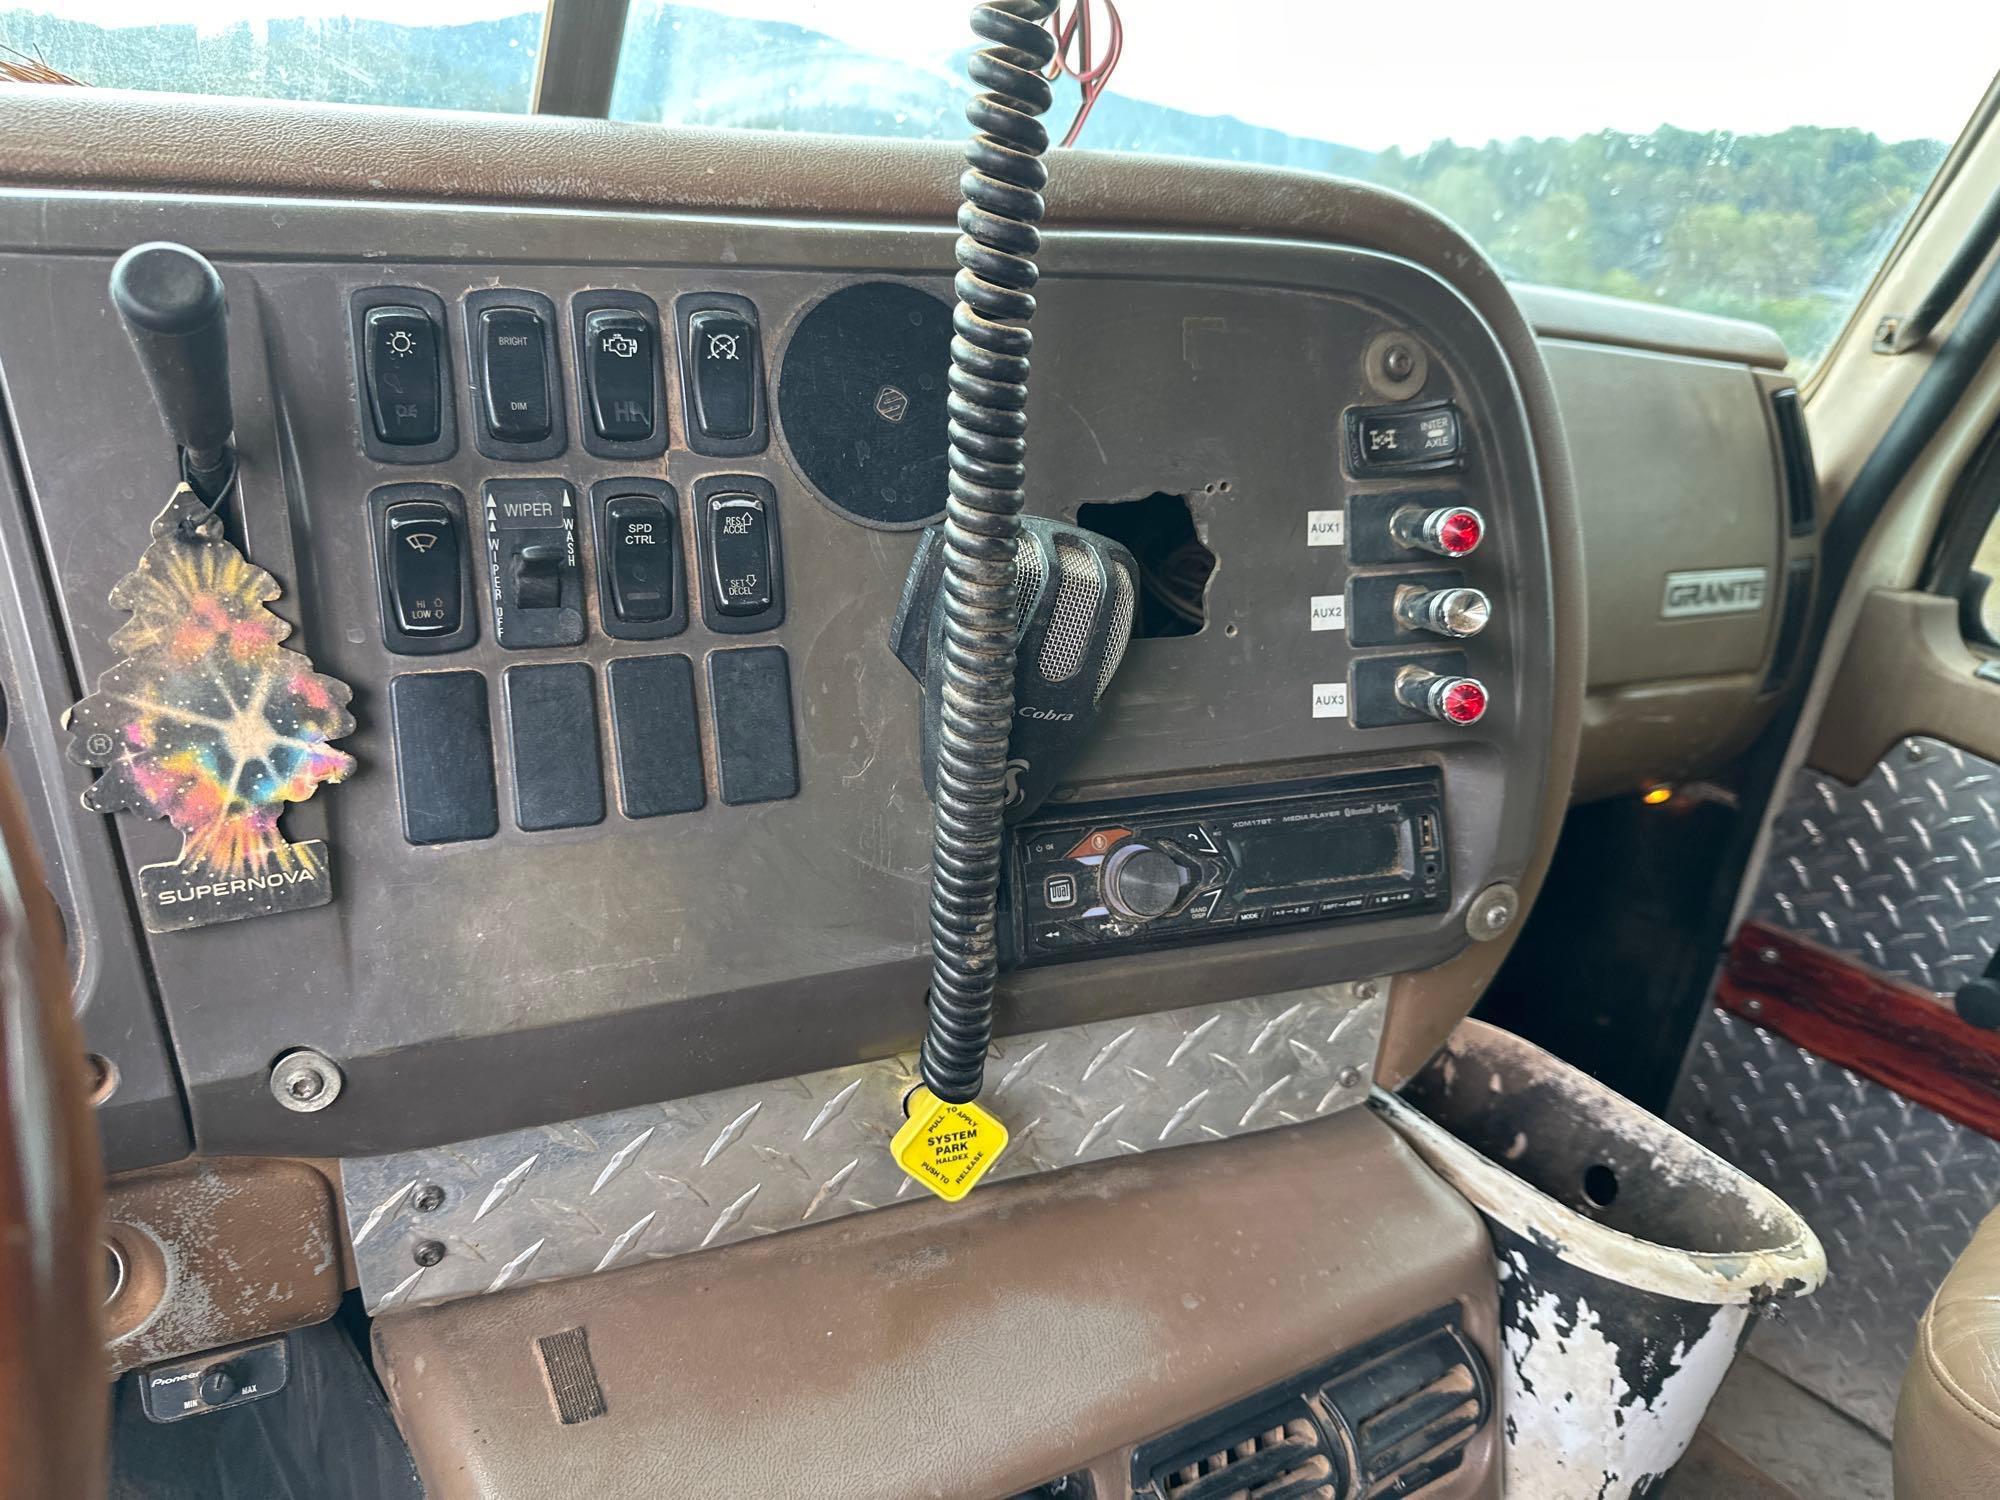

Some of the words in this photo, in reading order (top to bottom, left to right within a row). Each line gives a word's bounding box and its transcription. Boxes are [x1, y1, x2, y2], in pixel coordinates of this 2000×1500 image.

[499, 336, 528, 346] BRIGHT
[511, 402, 528, 411] DIM
[1420, 417, 1449, 431] INTER
[1424, 436, 1449, 449] AXLE
[504, 503, 553, 517] WIPER
[628, 523, 653, 533] SPD
[723, 525, 748, 534] ACCEL
[1311, 523, 1340, 533] AUX1
[563, 518, 576, 567] WASH
[625, 535, 656, 545] CTRL
[488, 538, 502, 601] WIPER
[730, 579, 745, 588] SET
[728, 587, 752, 596] DECEL
[1668, 580, 1765, 607] GRANITE
[412, 610, 431, 620] LOW
[1312, 607, 1342, 618] AUX2
[1315, 695, 1345, 706] AUX3
[1019, 706, 1074, 721] Cobra
[1309, 810, 1340, 819] PLAYER
[158, 868, 314, 906] SUPERNOVA
[928, 1114, 946, 1133] PULL
[946, 1106, 957, 1114] TO
[957, 1111, 978, 1127] APPLY
[928, 1129, 977, 1146] SYSTEM
[936, 1142, 968, 1156] PARK
[936, 1153, 968, 1165] HALDEX
[921, 1161, 939, 1177] PUSH
[939, 1174, 950, 1184] TO
[955, 1151, 984, 1184] RELEASE
[151, 1372, 201, 1388] Pioneer
[241, 1384, 258, 1395] MAX
